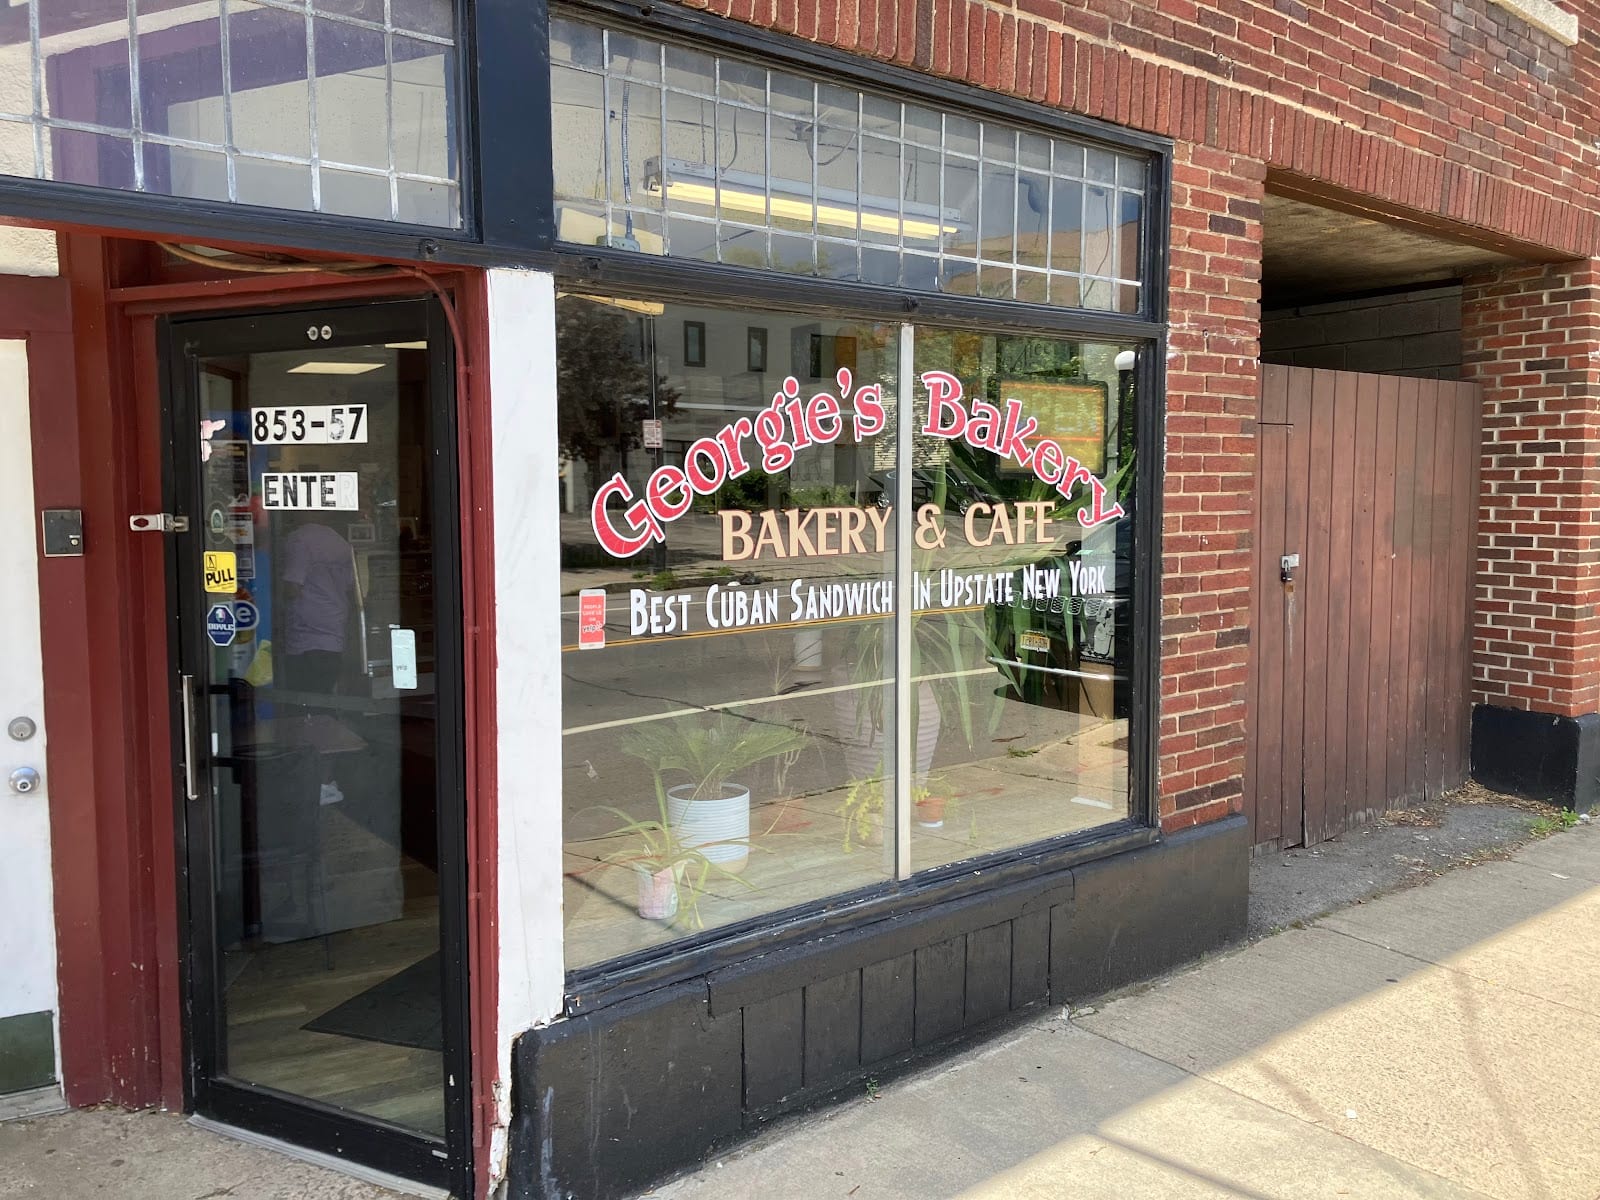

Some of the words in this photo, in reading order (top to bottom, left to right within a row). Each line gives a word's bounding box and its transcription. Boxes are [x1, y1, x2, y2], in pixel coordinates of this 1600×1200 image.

[254, 407, 364, 441] 853-57
[592, 367, 886, 558] Georgie's
[921, 371, 1124, 528] Bakery
[718, 506, 892, 561] BAKERY
[914, 503, 946, 549] &
[964, 501, 1055, 547] CAFE
[205, 568, 234, 586] PULL
[630, 588, 691, 636] BEST
[706, 584, 778, 628] CUBAN
[790, 578, 892, 621] SANDWICH
[913, 571, 931, 610] IN
[941, 569, 1014, 607] UPSTATE
[1023, 564, 1061, 598] NEW
[1069, 561, 1106, 594] YORK
